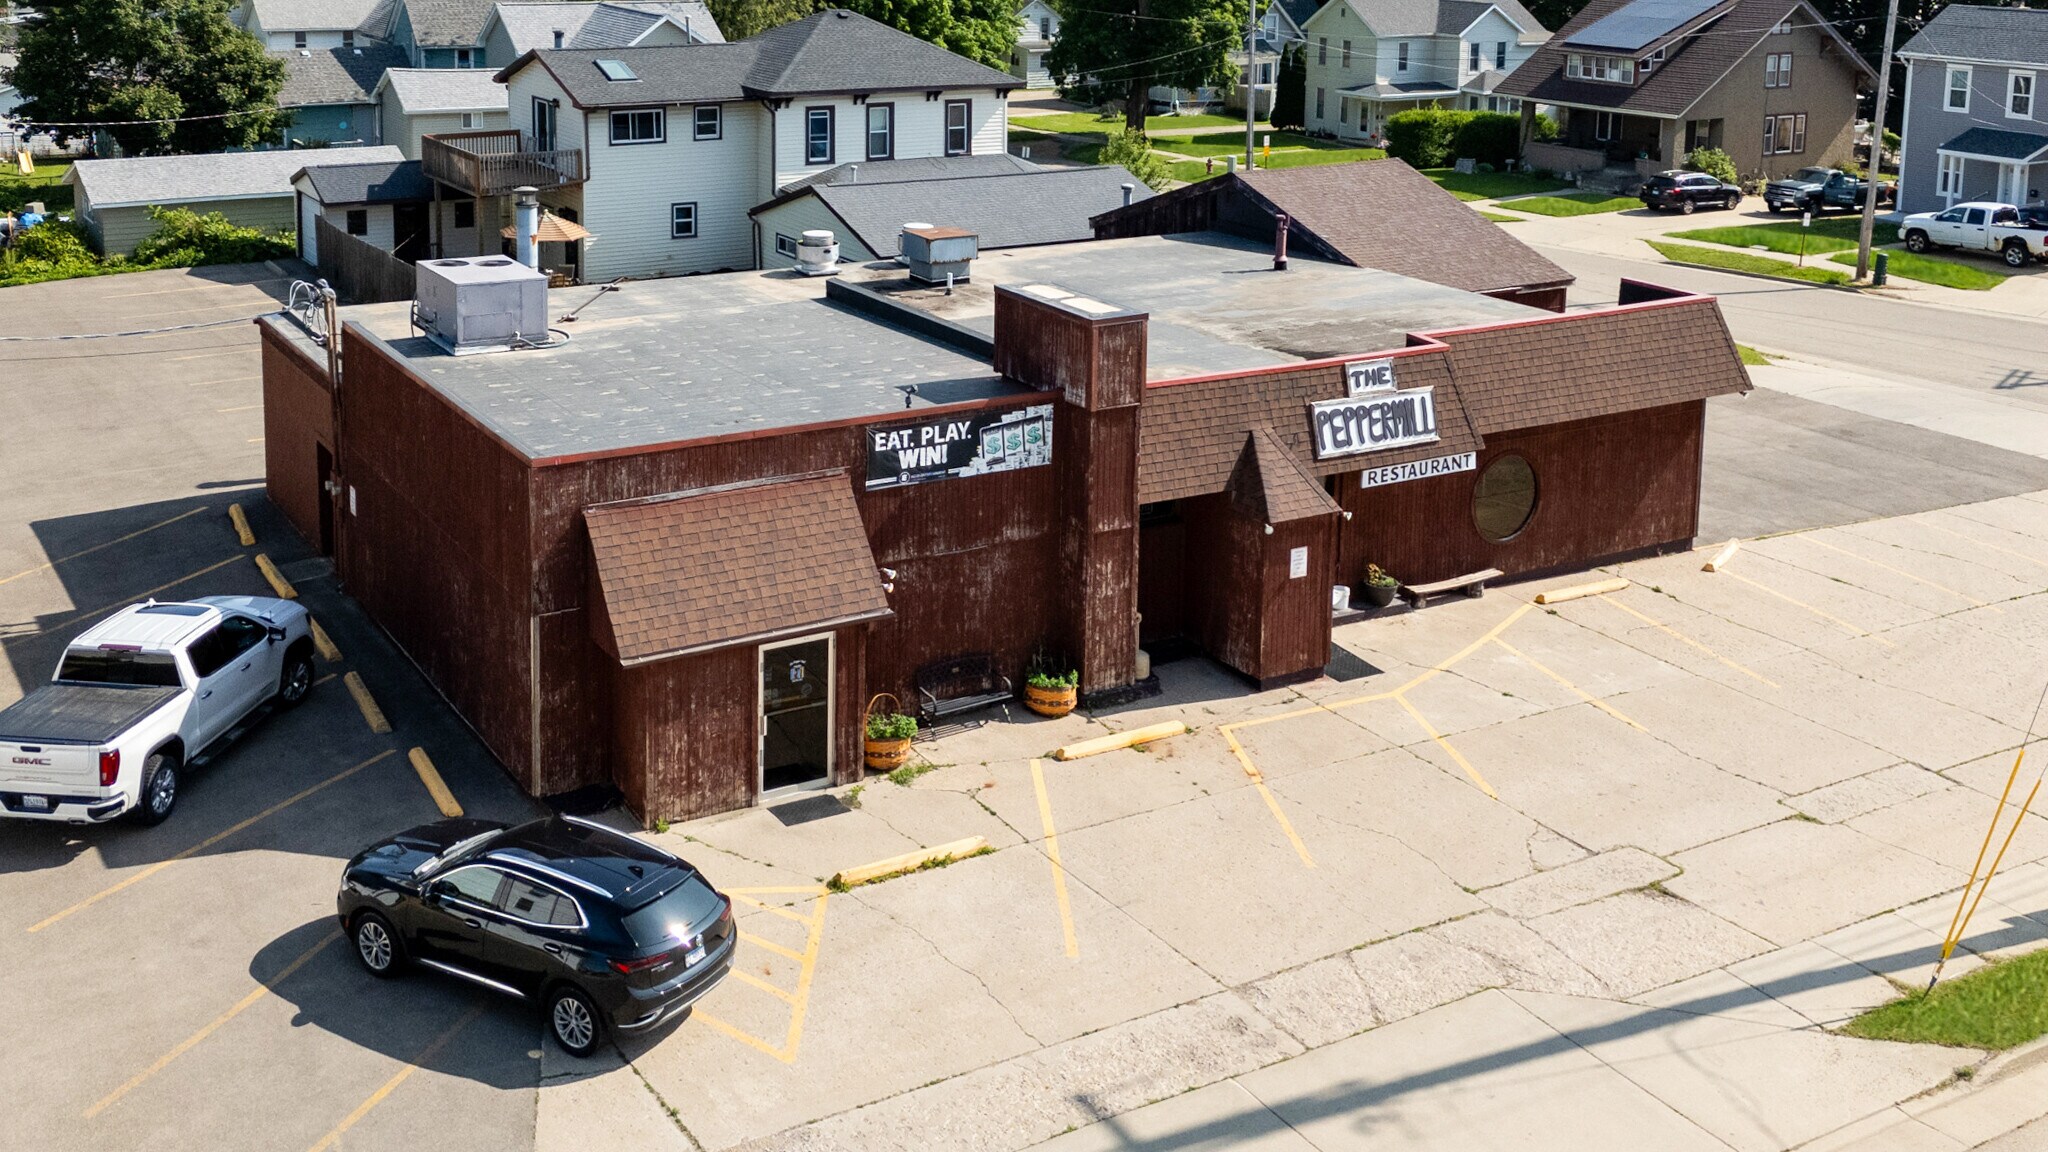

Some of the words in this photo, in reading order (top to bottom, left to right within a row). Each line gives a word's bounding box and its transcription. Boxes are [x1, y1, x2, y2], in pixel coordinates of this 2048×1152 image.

[1350, 366, 1391, 388] THE
[874, 428, 914, 451] EAT.
[921, 420, 972, 444] PLAY.
[1316, 396, 1436, 450] PEPPERMILL
[898, 444, 948, 470] WIN!
[1367, 454, 1472, 485] RESTAURANT
[12, 757, 51, 765] GMC
